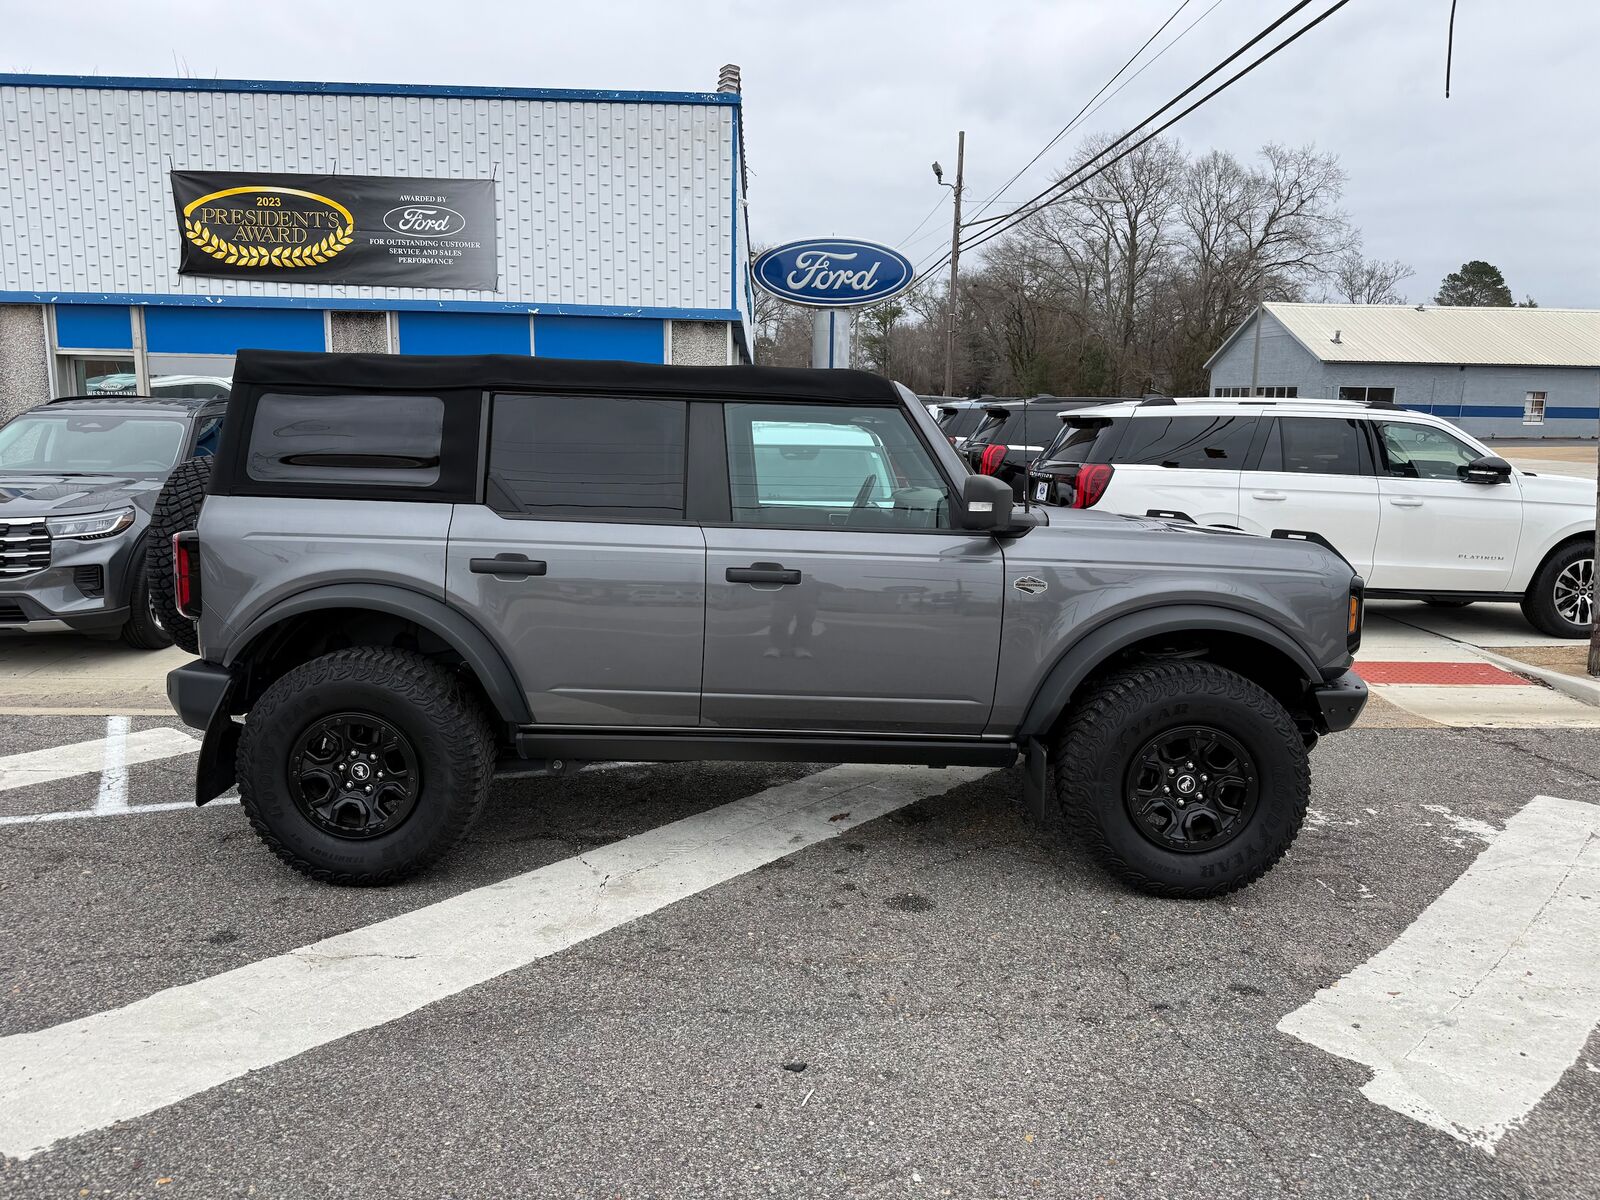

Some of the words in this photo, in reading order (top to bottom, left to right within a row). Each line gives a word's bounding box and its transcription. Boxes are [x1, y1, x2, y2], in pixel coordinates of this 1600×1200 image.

[256, 197, 281, 207] 2023
[201, 207, 340, 229] PRESIDENT'S
[398, 208, 450, 231] Ford
[232, 226, 308, 244] AWARD
[369, 238, 385, 246] FOR
[386, 239, 439, 247] OUTSTANDING
[440, 240, 481, 249] CUSTOMER
[388, 247, 421, 255] SERVICE
[422, 248, 438, 256] AND
[439, 249, 462, 257] SALES
[398, 256, 454, 265] PERFORMANCE
[786, 250, 882, 291] Ford
